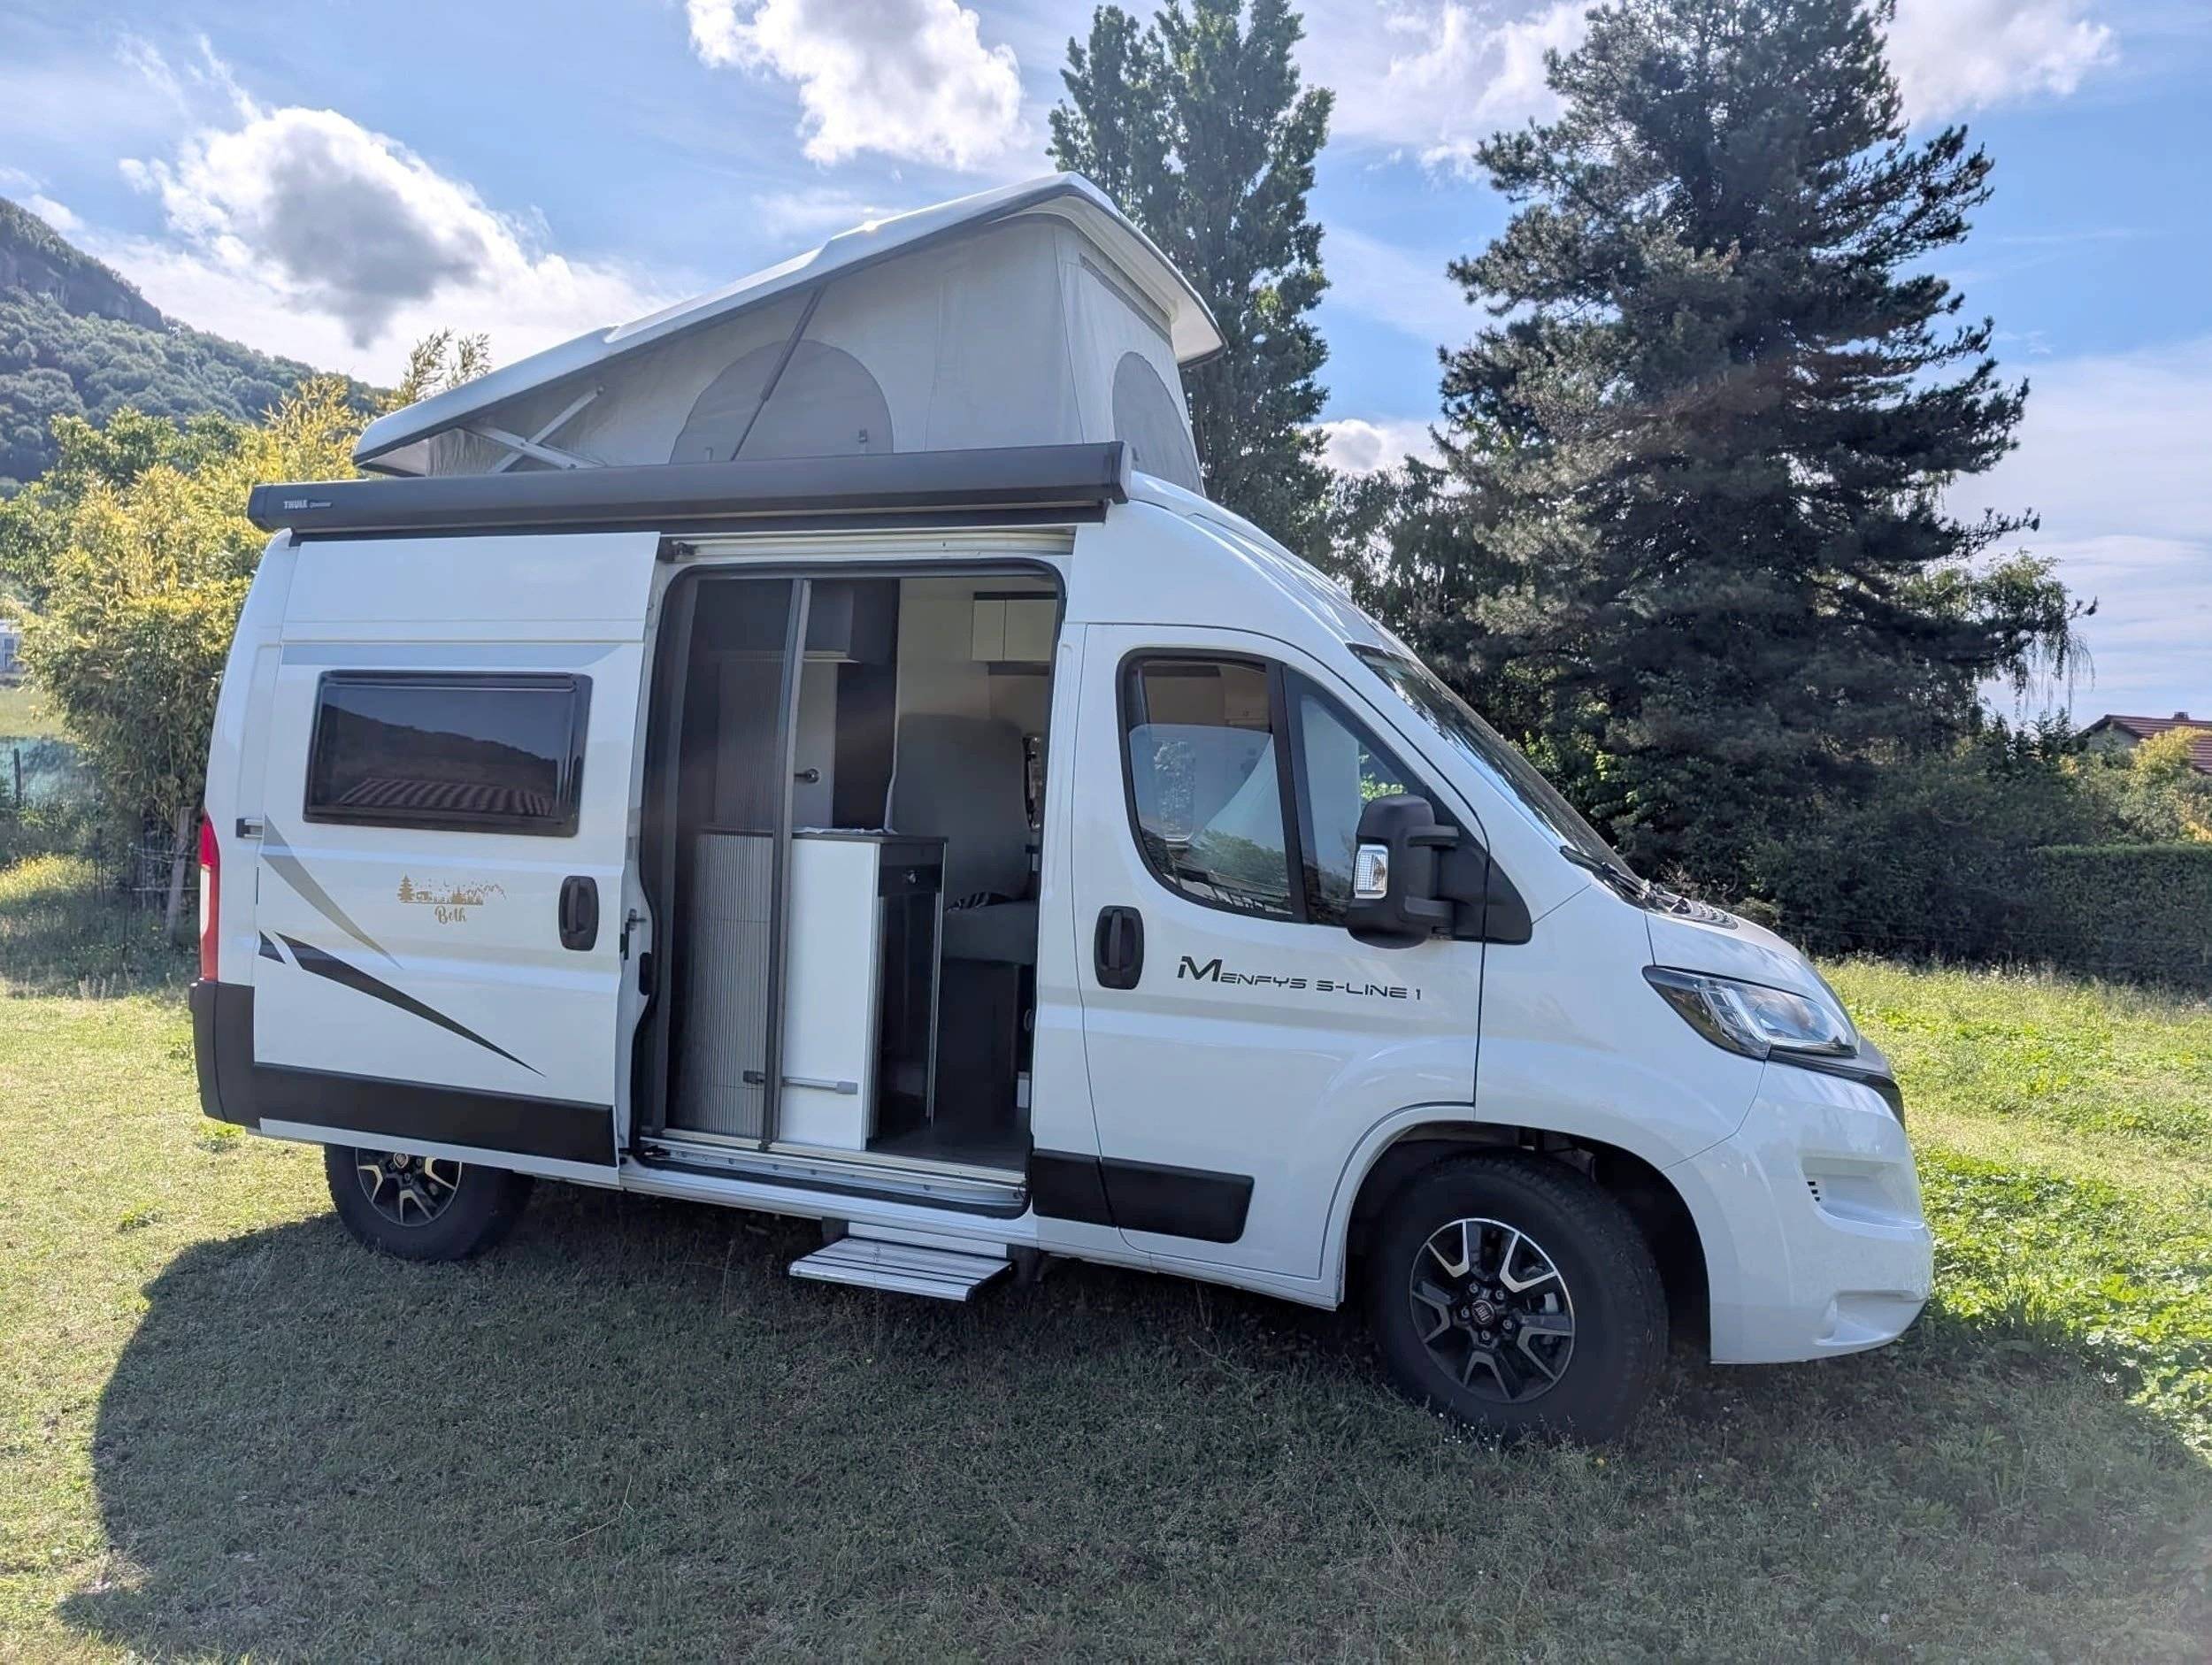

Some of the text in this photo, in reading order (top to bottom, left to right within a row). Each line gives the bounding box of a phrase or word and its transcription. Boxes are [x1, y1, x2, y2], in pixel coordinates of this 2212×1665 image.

[283, 499, 308, 510] THULE
[1177, 955, 1422, 1001] MENFYS S-LINE 1
